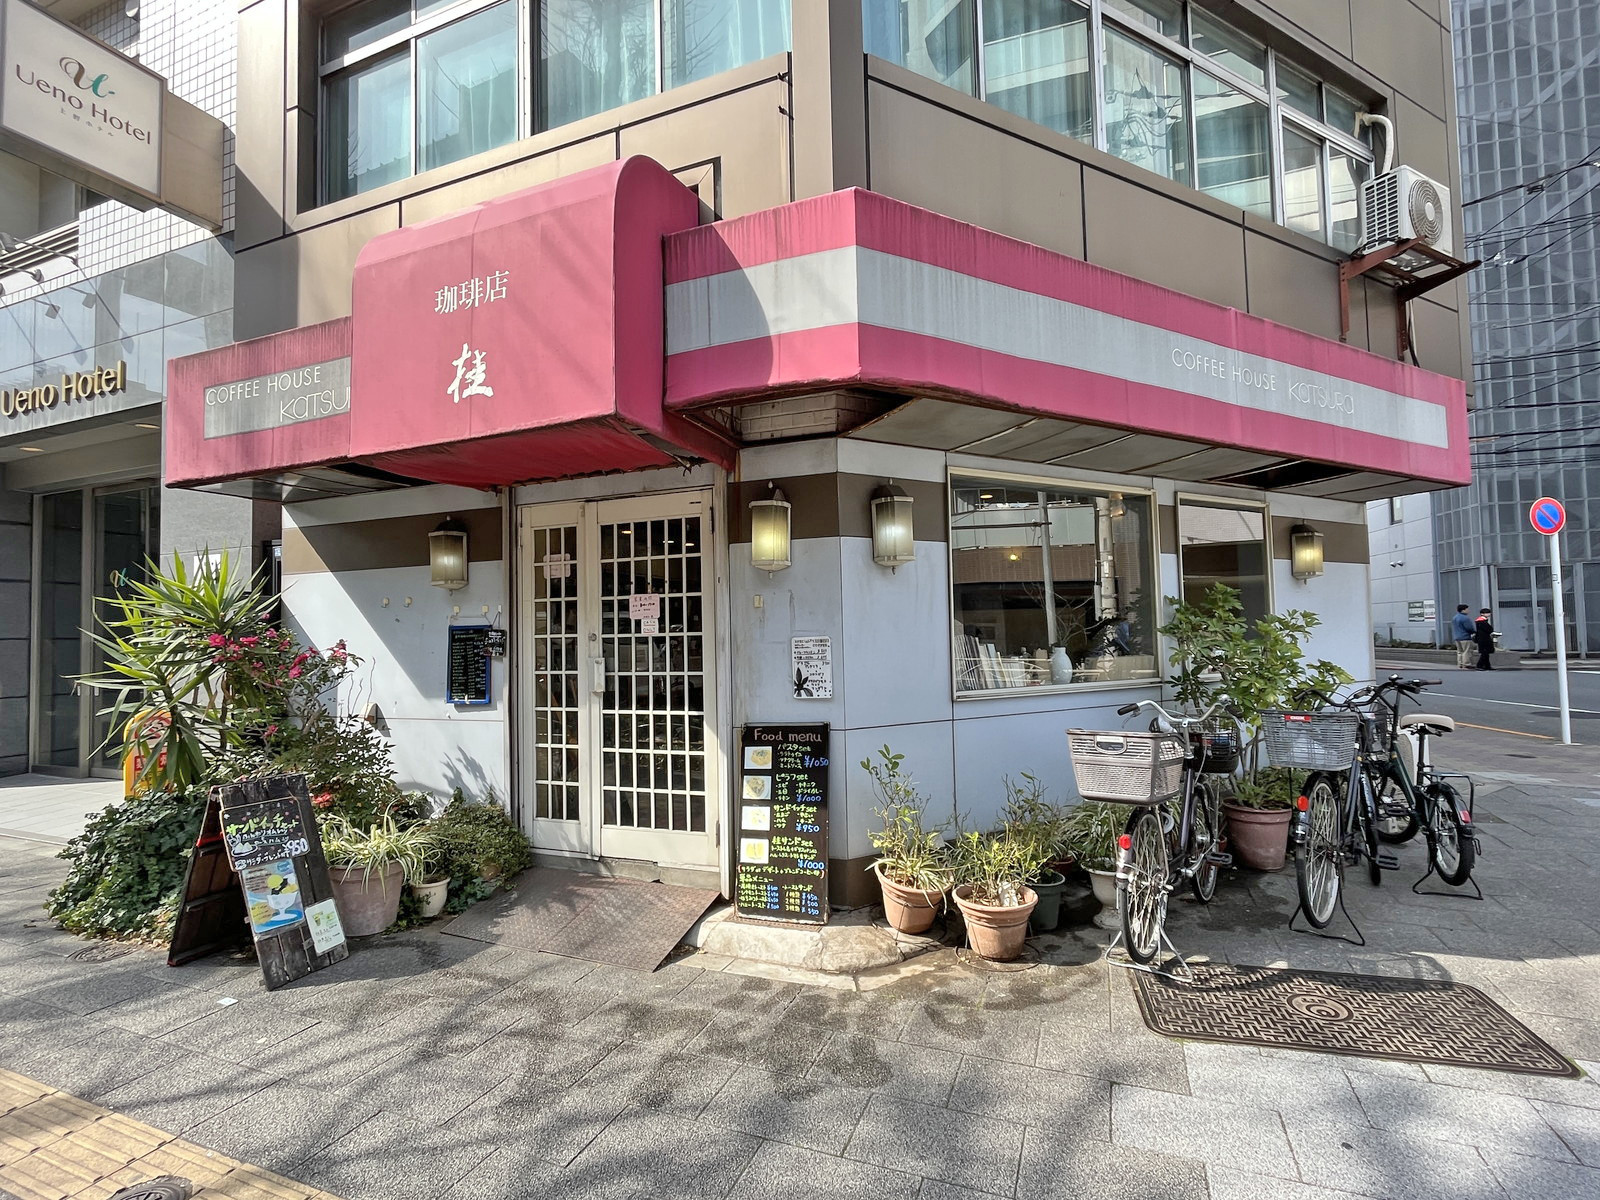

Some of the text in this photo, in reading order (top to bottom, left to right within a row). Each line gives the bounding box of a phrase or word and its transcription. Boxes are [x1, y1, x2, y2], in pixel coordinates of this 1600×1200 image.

[16, 63, 151, 145] Ueno Hotel
[434, 270, 510, 314] 珈琲店
[1, 360, 127, 417] Ueno Hotel
[205, 366, 322, 406] COFFEE HOUSE
[447, 342, 494, 404] 桂
[1171, 348, 1226, 379] COFFEE
[1232, 366, 1277, 391] HOUSE
[754, 727, 822, 742] Food menu
[803, 754, 829, 768] ¥1050
[796, 793, 822, 803] ¥1000
[795, 823, 820, 833] ¥950
[797, 858, 825, 871] ¥1000
